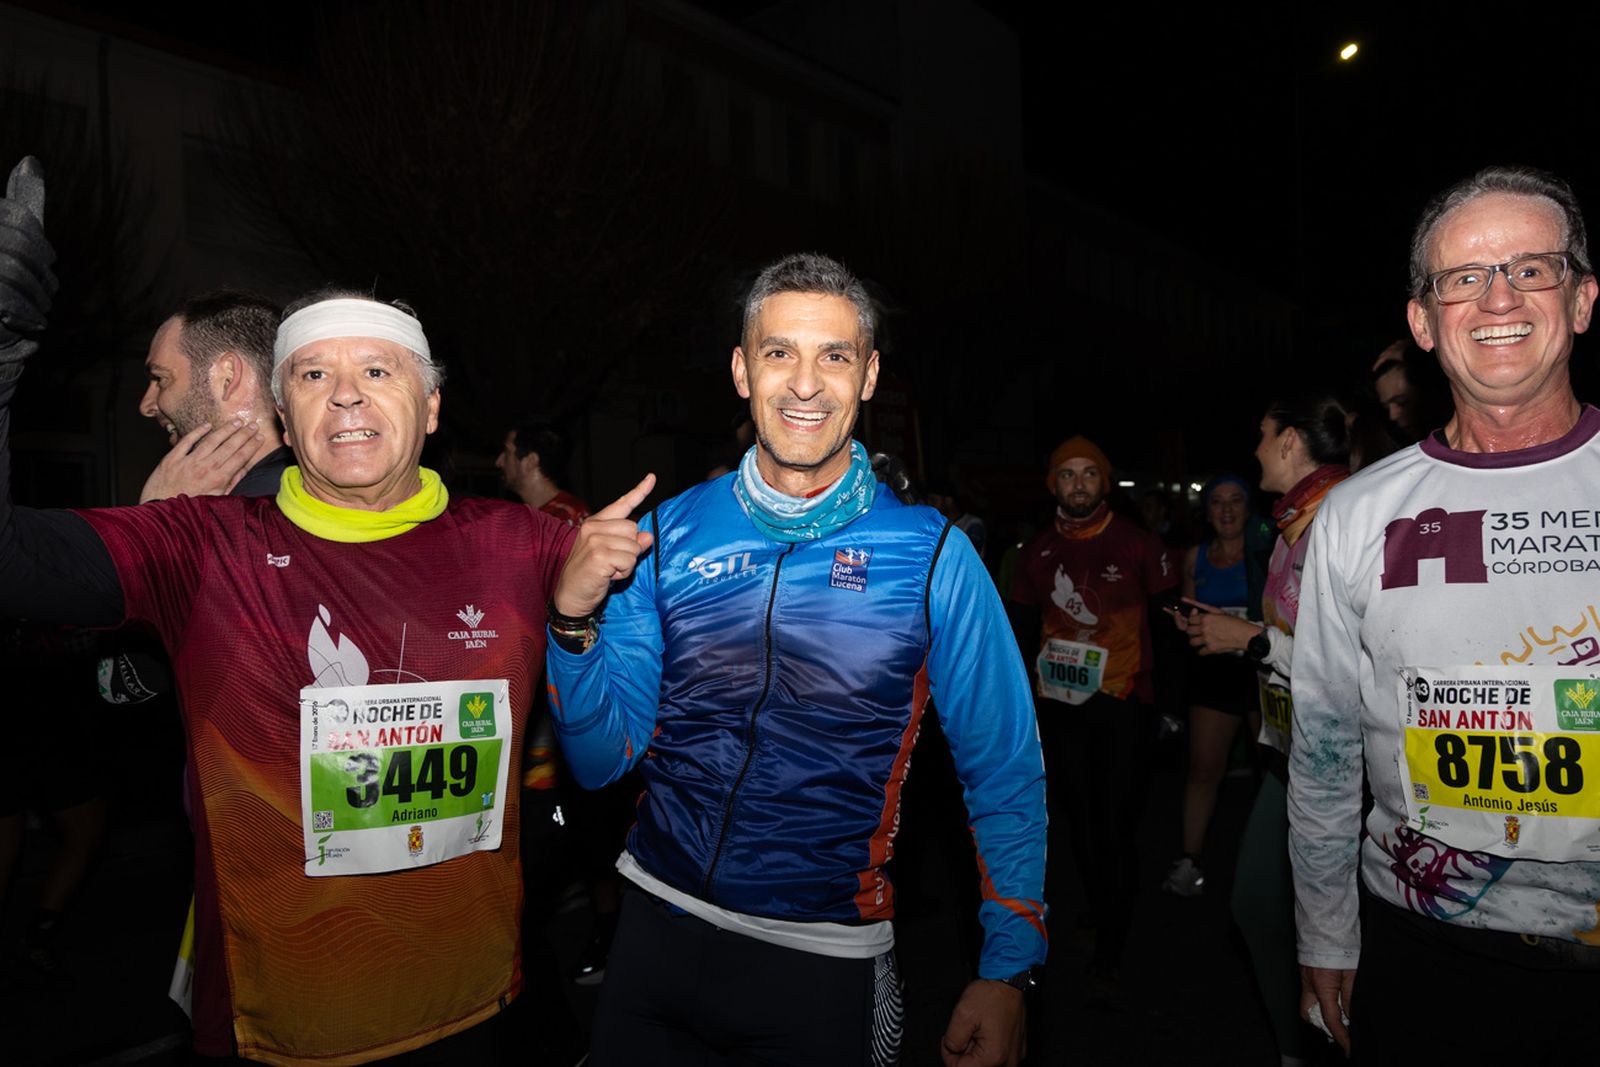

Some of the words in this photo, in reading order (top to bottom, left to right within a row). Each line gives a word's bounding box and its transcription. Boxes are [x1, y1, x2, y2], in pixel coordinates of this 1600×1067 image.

[1419, 522, 1441, 534] 35
[1490, 512, 1530, 531] 35
[698, 552, 757, 578] GTL
[832, 563, 853, 574] Club
[1492, 558, 1600, 574] CÓRDOBA
[831, 579, 863, 592] Lucena
[832, 571, 867, 584] Maratón
[1065, 598, 1082, 615] 43
[448, 631, 470, 640] CAJA
[471, 630, 499, 638] RURAL
[465, 639, 487, 649] JAÉN
[1048, 662, 1089, 686] 7006
[1433, 687, 1499, 704] NOCHE
[1505, 687, 1531, 704] DE
[353, 704, 415, 724] NOCHE
[419, 703, 443, 720] DE
[1418, 708, 1451, 729] SAN
[1456, 705, 1533, 731] ANTÓN
[374, 721, 443, 748] ANTÓN
[1434, 733, 1584, 795] 8758
[345, 745, 478, 808] 3449
[1463, 794, 1513, 811] Antonio
[1517, 798, 1558, 813] Jesús
[392, 808, 438, 822] Adriano
